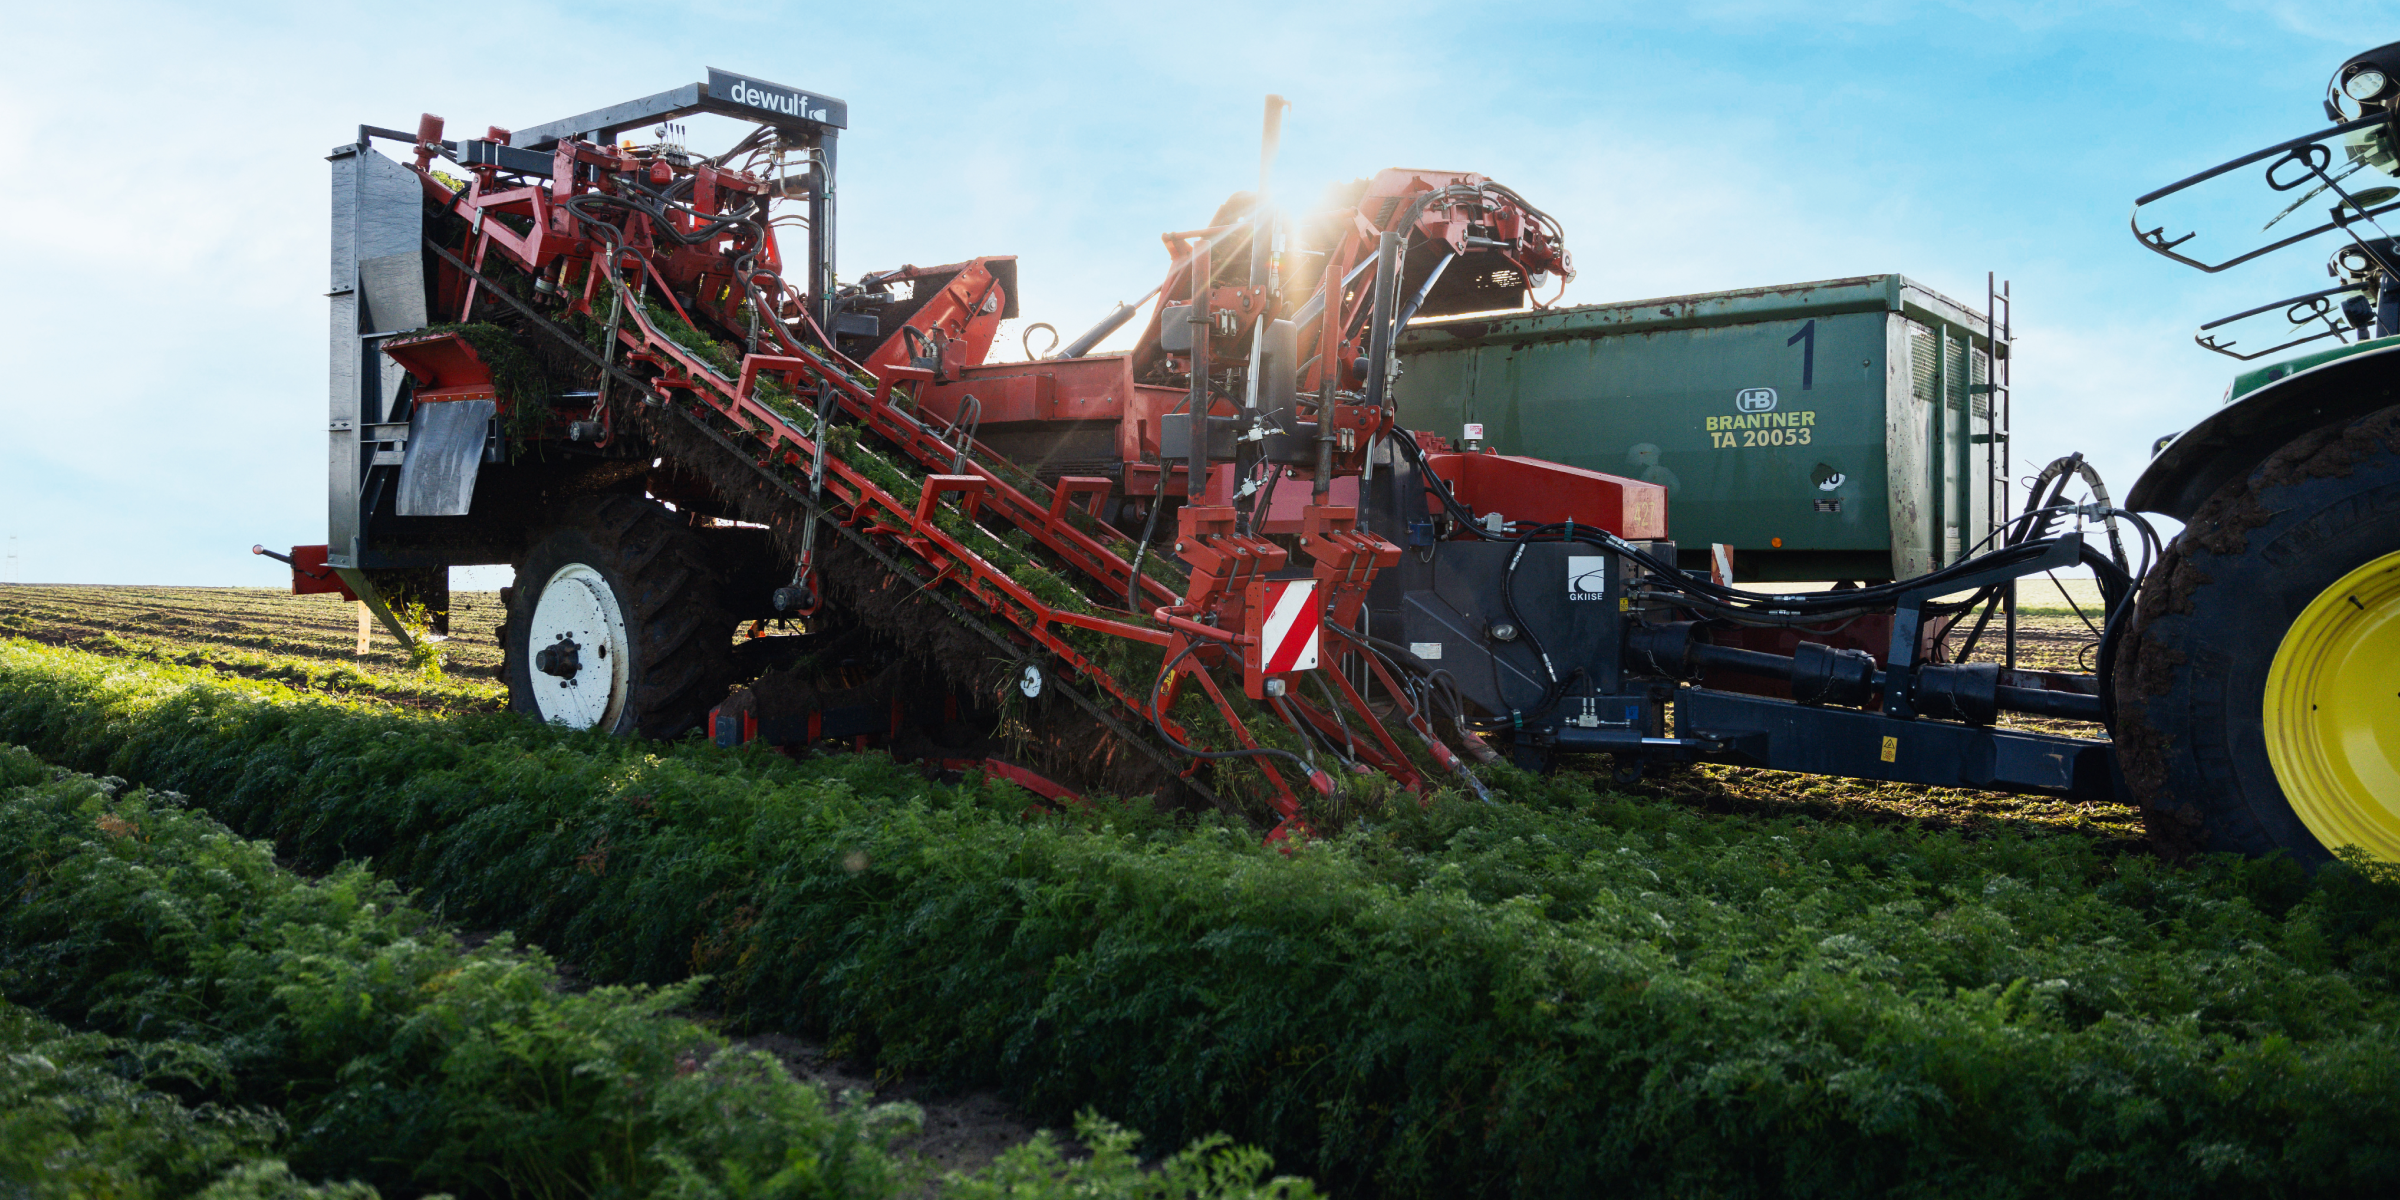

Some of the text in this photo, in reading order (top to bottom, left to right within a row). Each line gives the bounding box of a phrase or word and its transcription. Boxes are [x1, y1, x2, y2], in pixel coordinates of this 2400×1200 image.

[731, 80, 808, 118] dewulf
[1787, 320, 1815, 390] 1
[1744, 391, 1771, 409] HB
[1706, 411, 1816, 431] BRANTNER
[1710, 428, 1812, 448] TA 20053
[1634, 502, 1655, 526] 427
